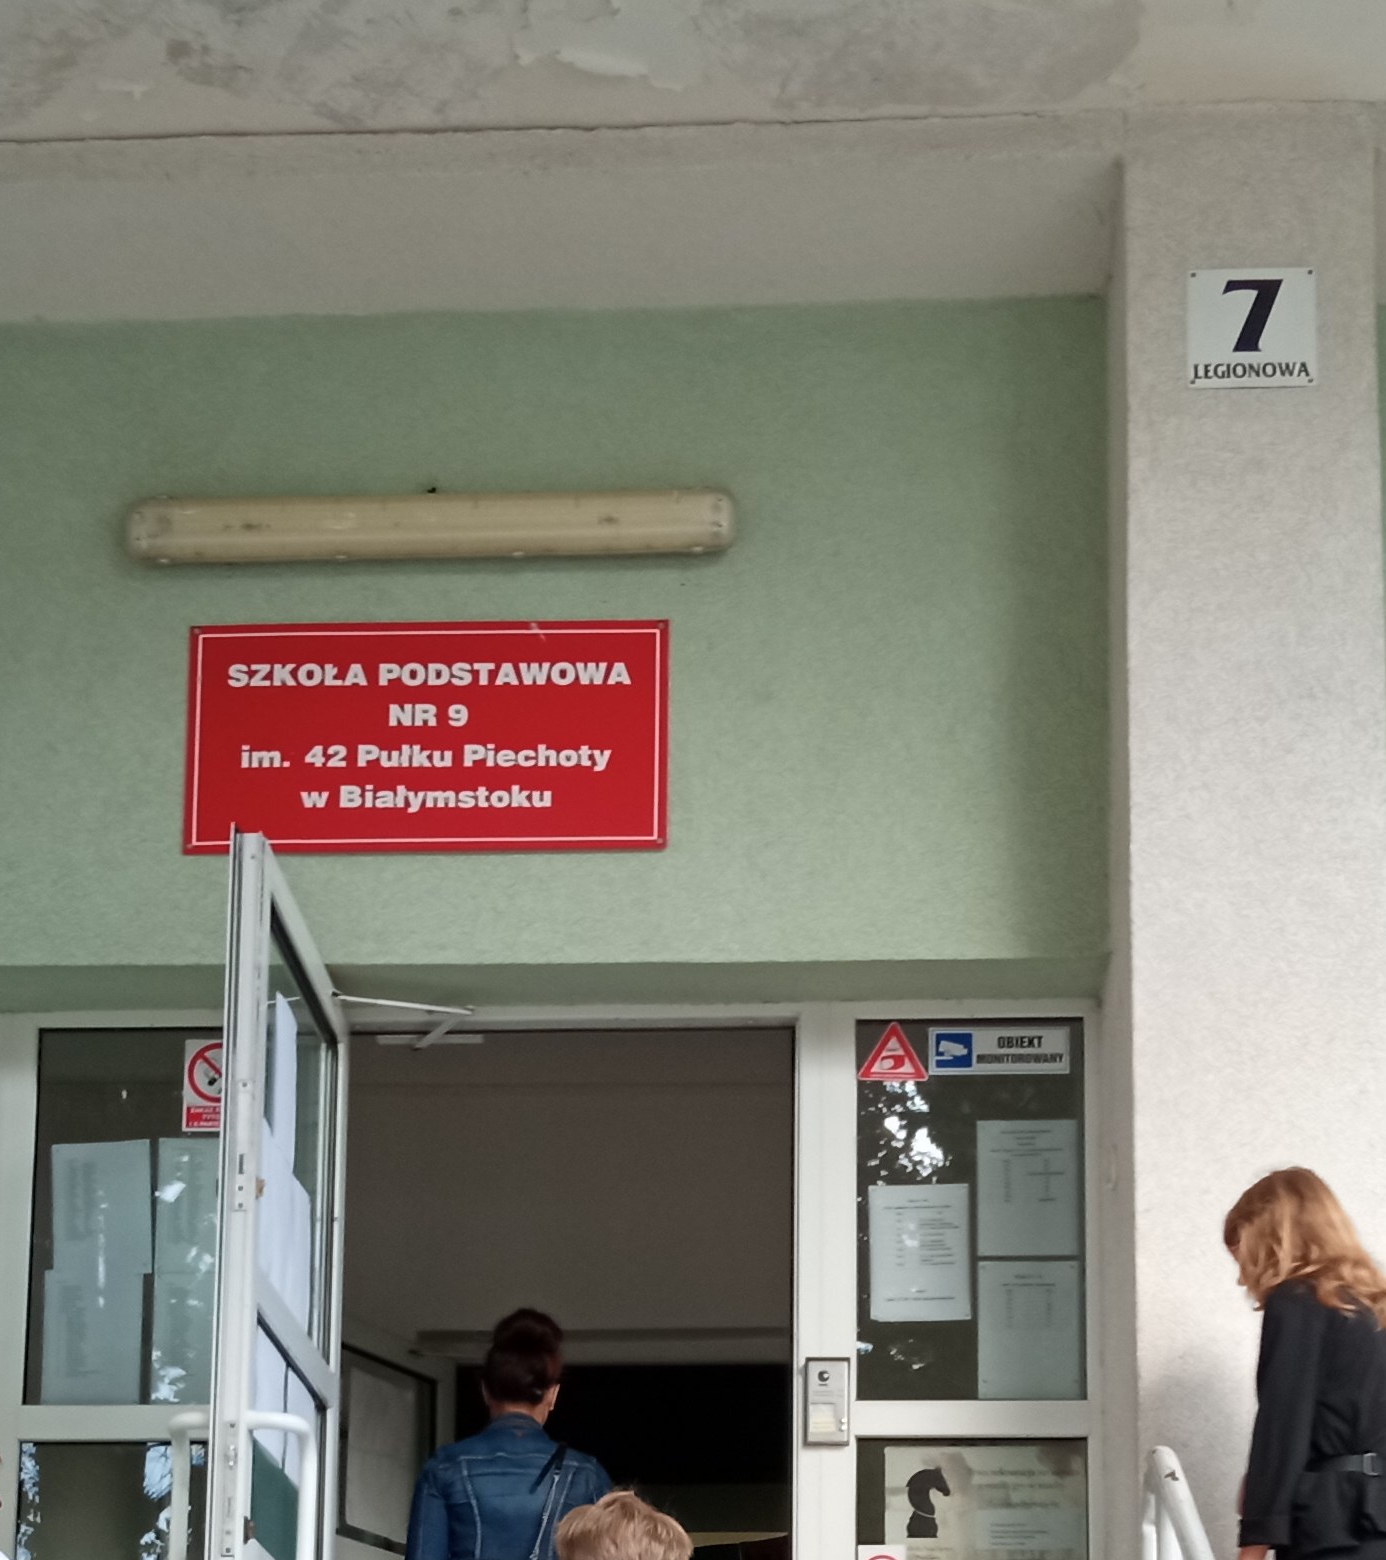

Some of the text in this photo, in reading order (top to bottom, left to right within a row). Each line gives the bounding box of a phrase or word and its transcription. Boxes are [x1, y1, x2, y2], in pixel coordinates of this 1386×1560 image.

[1222, 279, 1284, 352] 7
[1193, 361, 1310, 380] LEGIONOWA
[228, 662, 631, 687] SZKOŁA PODSTAWOWA
[388, 703, 469, 727] NR 9
[241, 744, 612, 771] im. 42 Pułku Piechoty
[300, 785, 552, 813] w Białymstoku
[997, 1036, 1043, 1049] OBIEKT
